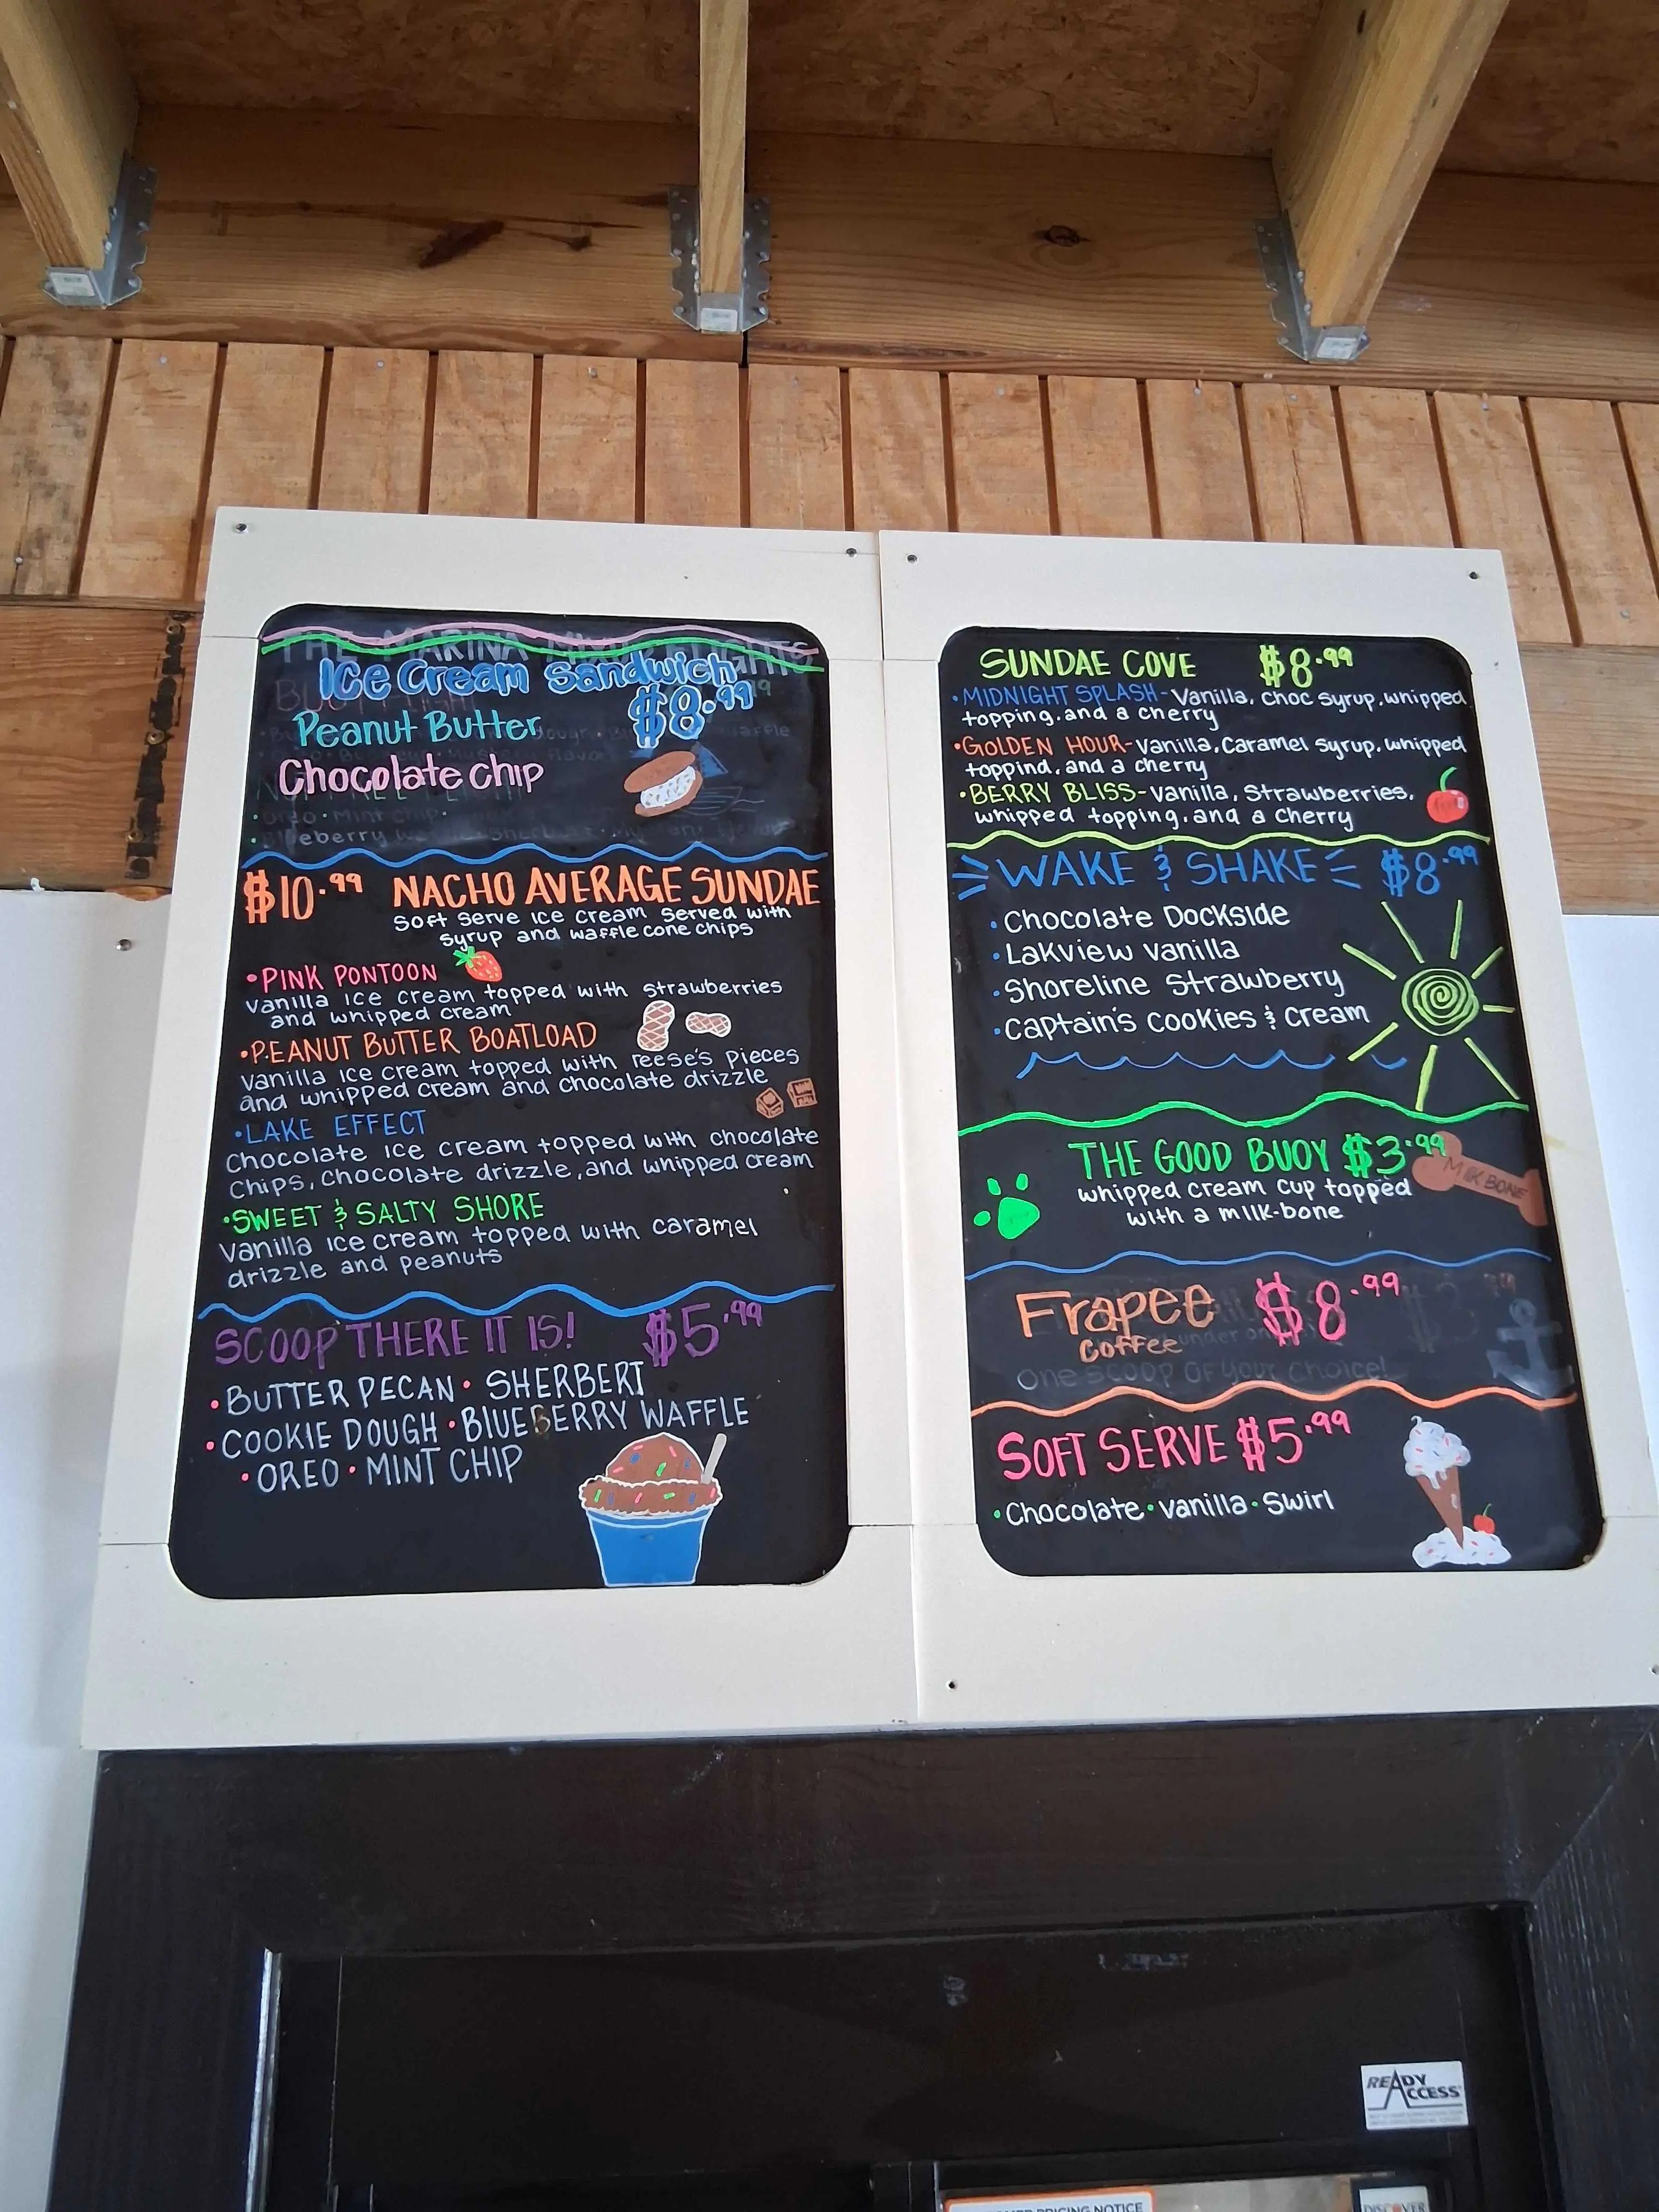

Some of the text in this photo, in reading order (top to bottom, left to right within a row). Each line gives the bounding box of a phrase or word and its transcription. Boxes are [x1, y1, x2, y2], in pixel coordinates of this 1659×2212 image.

[980, 645, 1353, 687] SUNDAE COVE $8.99
[964, 685, 1068, 707] MIDNIGHT
[1384, 690, 1467, 710] whipped
[1065, 706, 1107, 721] and
[1117, 707, 1129, 720] a
[292, 710, 417, 747] Peanut
[423, 710, 543, 742] Butter
[628, 680, 753, 751] $8.99
[1385, 736, 1467, 757] whipped
[1066, 759, 1104, 773] and
[1111, 760, 1125, 774] a
[969, 782, 1051, 804] BERRY
[975, 807, 1075, 827] whipped
[1193, 808, 1240, 825] and
[1252, 810, 1265, 824] a
[995, 845, 1477, 897] WAKE & SHAKE $8.99
[243, 865, 820, 923] $10.99 NACHO AVERAGE SUNDAE
[576, 907, 647, 923] cream
[747, 905, 792, 919] with
[1163, 903, 1290, 928] Dockside
[440, 922, 753, 948] syrup and waffle cone chips
[262, 963, 436, 993] PINK PONTOON
[398, 990, 474, 1004] cream
[484, 983, 566, 1006] topped
[577, 981, 628, 997] with
[644, 979, 782, 998] strawberries
[1005, 968, 1345, 1003] Shoreline Strawberry
[271, 1004, 511, 1028] and whipped cream
[1264, 1005, 1276, 1030] &
[251, 1022, 596, 1064] PEANUT BUTTER BOATLOAD
[382, 1063, 458, 1080] cream
[469, 1058, 551, 1079] topped
[562, 1054, 617, 1071] with
[725, 1048, 799, 1069] pieces
[240, 1094, 287, 1112] and
[301, 1082, 409, 1105] whipped
[418, 1082, 490, 1097] cream
[502, 1079, 549, 1096] and
[684, 1068, 768, 1088] drizzle
[247, 1110, 426, 1143] LAKE EFFECT
[439, 1140, 528, 1156] cream
[538, 1133, 635, 1155] topped
[644, 1131, 696, 1148] with
[1068, 1131, 1446, 1179] THE GOOD BUOY $3.99
[586, 1158, 632, 1176] and
[644, 1154, 738, 1177] whipped
[746, 1154, 814, 1168] cream
[1078, 1175, 1412, 1206] whipped cream cup topped
[233, 1193, 543, 1233] SWEET & SALTY SHORE
[1127, 1207, 1184, 1226] with
[1194, 1208, 1209, 1223] a
[373, 1231, 458, 1250] cream
[471, 1226, 571, 1248] topped
[581, 1221, 640, 1239] with
[653, 1218, 757, 1237] caramel
[228, 1248, 502, 1288] drizzle and peanuts
[1256, 1272, 1399, 1346] $8.99
[216, 1327, 337, 1369] SCOOP
[346, 1318, 468, 1358] THERE
[486, 1316, 512, 1353] IT
[642, 1300, 761, 1367] $5.99
[227, 1361, 644, 1415] BUTTER PECAN SHERBERT
[222, 1422, 331, 1458] COOKIE
[343, 1411, 441, 1450] DOUGH
[641, 1397, 749, 1429] WAFFLE
[998, 1411, 1352, 1480] SOFT SERVE $5.99
[258, 1444, 522, 1492] OREO MINT CHIP
[1263, 1490, 1334, 1515] Swirl
[1094, 2202, 1143, 2212] NOTICE
